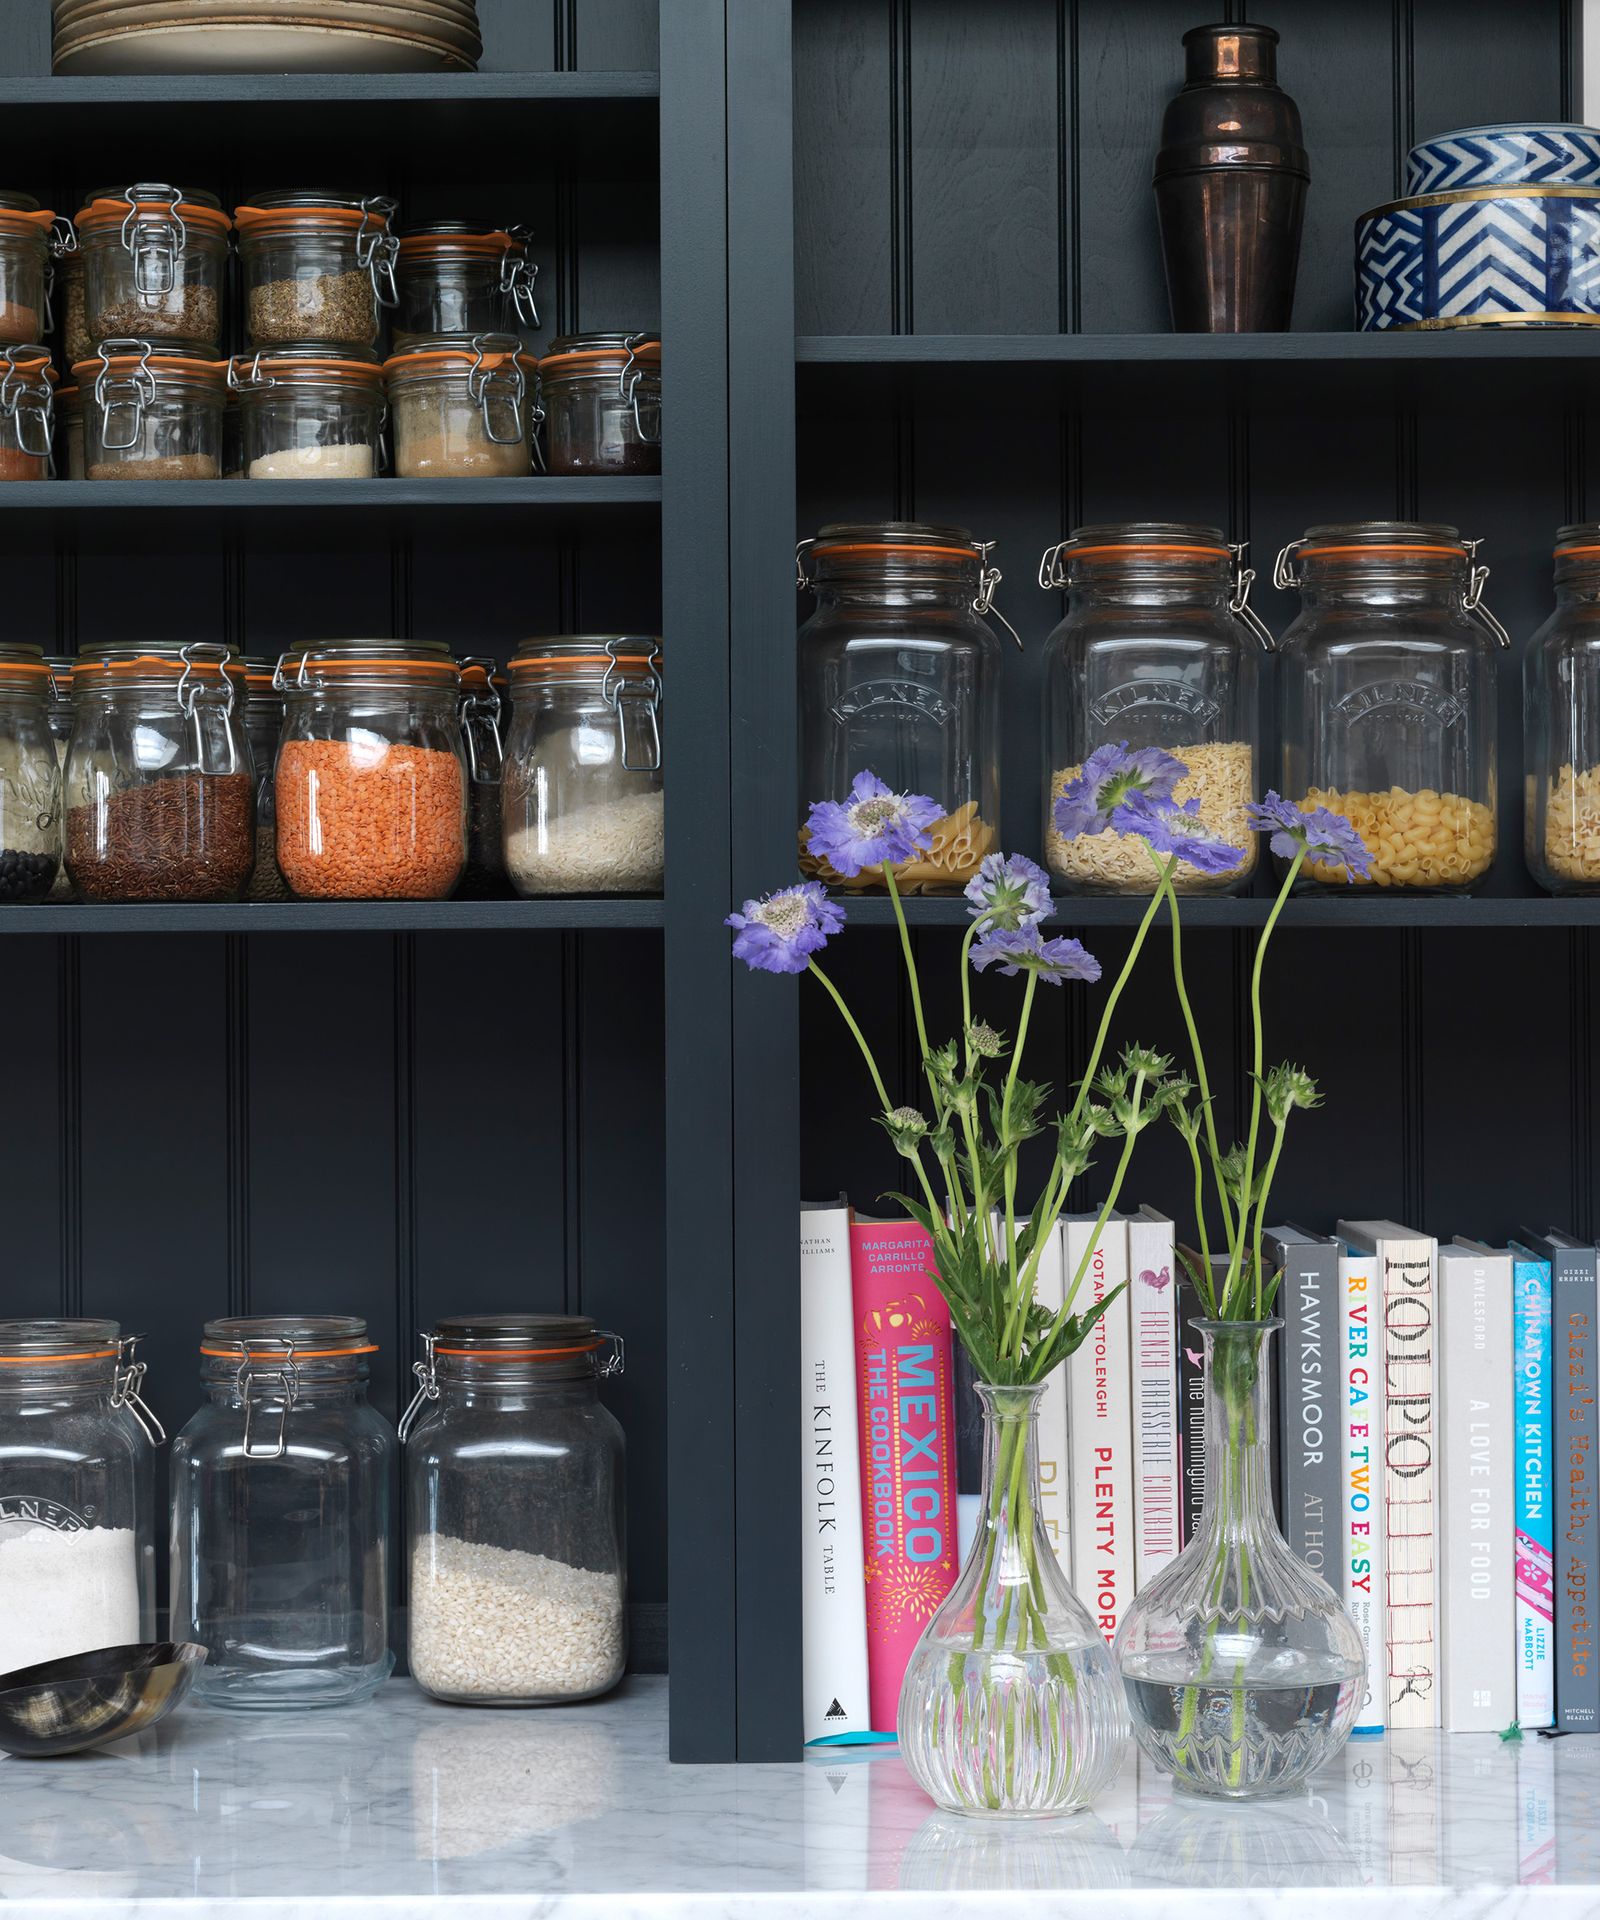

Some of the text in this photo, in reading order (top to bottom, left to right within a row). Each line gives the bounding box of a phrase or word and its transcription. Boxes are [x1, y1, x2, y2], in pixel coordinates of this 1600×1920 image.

[830, 682, 949, 725] KILNER
[1092, 683, 1216, 724] KILNER
[1335, 682, 1462, 725] KILNER
[861, 1239, 931, 1251] MARGARITA
[868, 1251, 926, 1263] CARRILLO
[870, 1263, 925, 1274] ARRONTE
[1093, 1248, 1108, 1419] YOTAM OTTOLENGHI
[1473, 1269, 1485, 1350] DAYLESFORD
[1299, 1271, 1324, 1467] HAWKSMOOR
[1385, 1256, 1431, 1478] POLPO
[1524, 1278, 1542, 1519] CHINATOWN KITCHEN
[813, 1360, 837, 1595] THE KINFOLK TABLE
[867, 1348, 896, 1557] THE COOKBOOK
[897, 1344, 942, 1563] MEXICO
[1140, 1311, 1173, 1556] FRENCH BRASSERIE COOKBOOK
[1348, 1276, 1371, 1593] RIVER CAFE TWO EASY
[1094, 1447, 1115, 1557] PLENTY
[1304, 1492, 1324, 1523] AT
[1469, 1399, 1491, 1599] A LOVE FOR FOOD
[1566, 1312, 1595, 1677] Gizzi's Healthy Appetite
[1362, 1601, 1371, 1624] Rose
[1524, 1617, 1534, 1671] MABBOTT
[1535, 1627, 1545, 1661] LIZZIE
